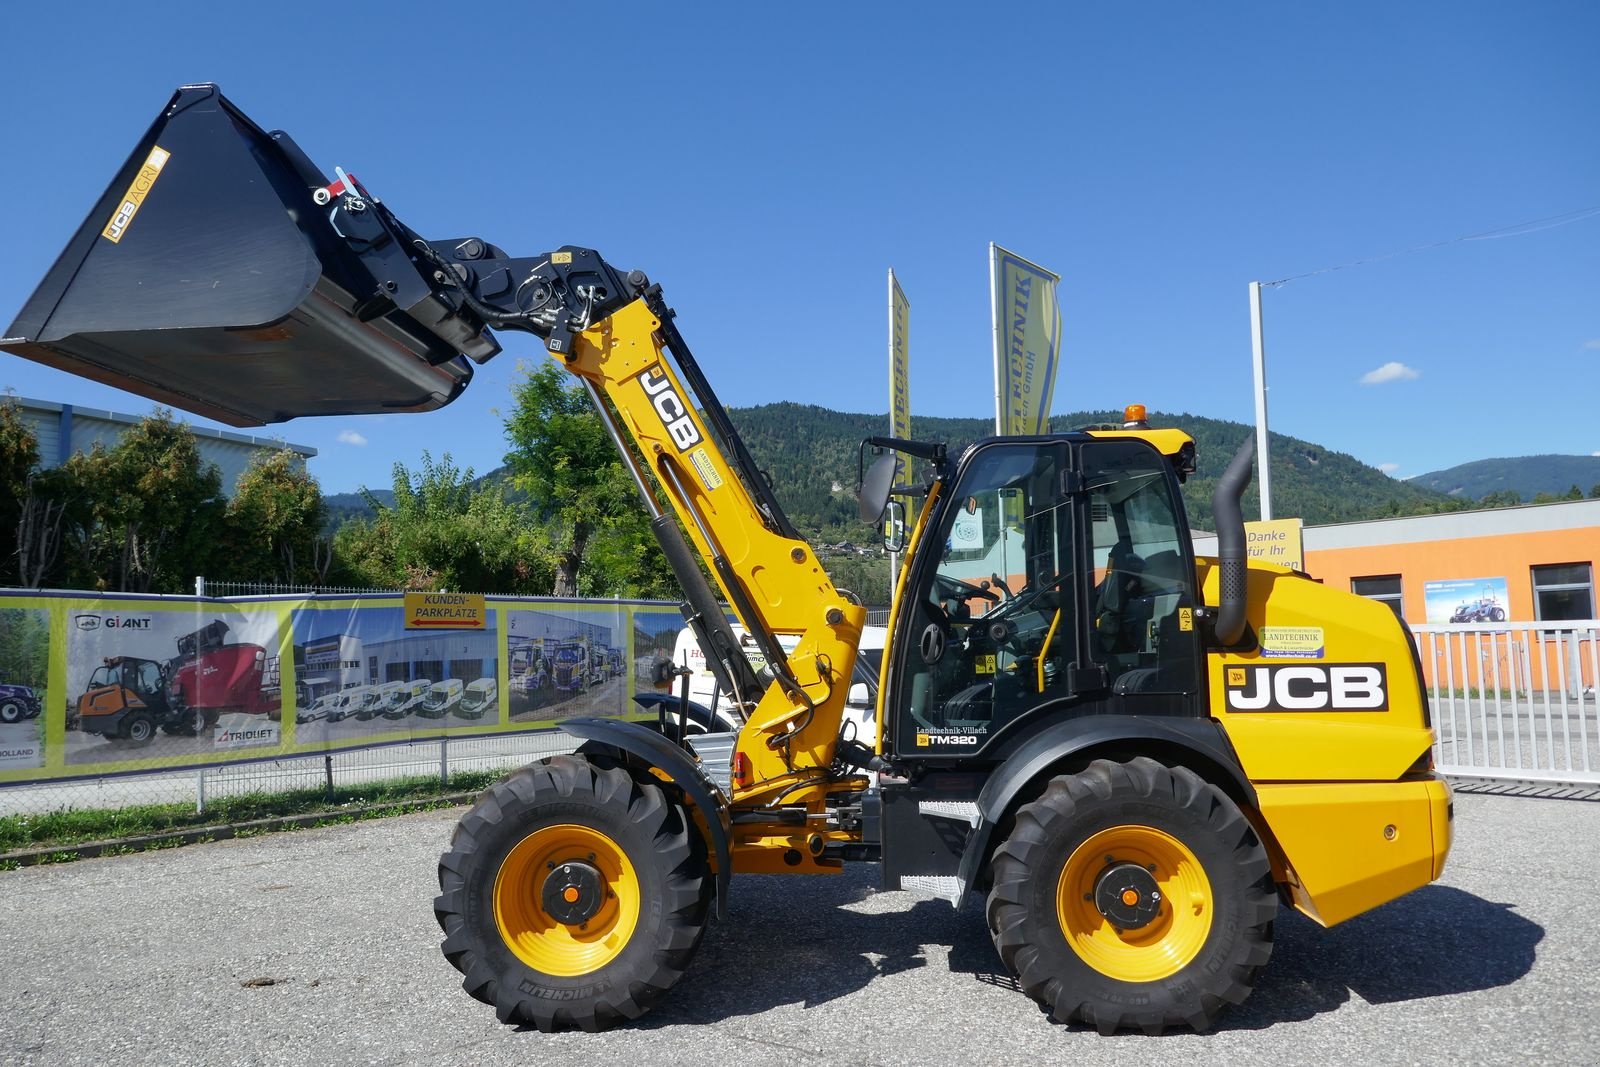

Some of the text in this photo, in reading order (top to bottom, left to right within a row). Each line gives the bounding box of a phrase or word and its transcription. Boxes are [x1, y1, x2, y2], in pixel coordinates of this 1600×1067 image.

[110, 165, 158, 238] JCB AGRI
[1022, 351, 1037, 394] GmbH
[640, 372, 700, 450] JCB
[697, 449, 722, 485] LANDTECHNIK
[1248, 530, 1286, 542] Danke
[1247, 544, 1286, 557] für Ihr
[424, 595, 470, 605] KUNDEN-
[415, 605, 477, 618] PARKPLÄTZE
[1263, 633, 1319, 641] LANDTECHNIK
[1228, 667, 1385, 710] JCB
[916, 726, 987, 734] Landtechnik-Villach
[928, 735, 977, 745] TM320
